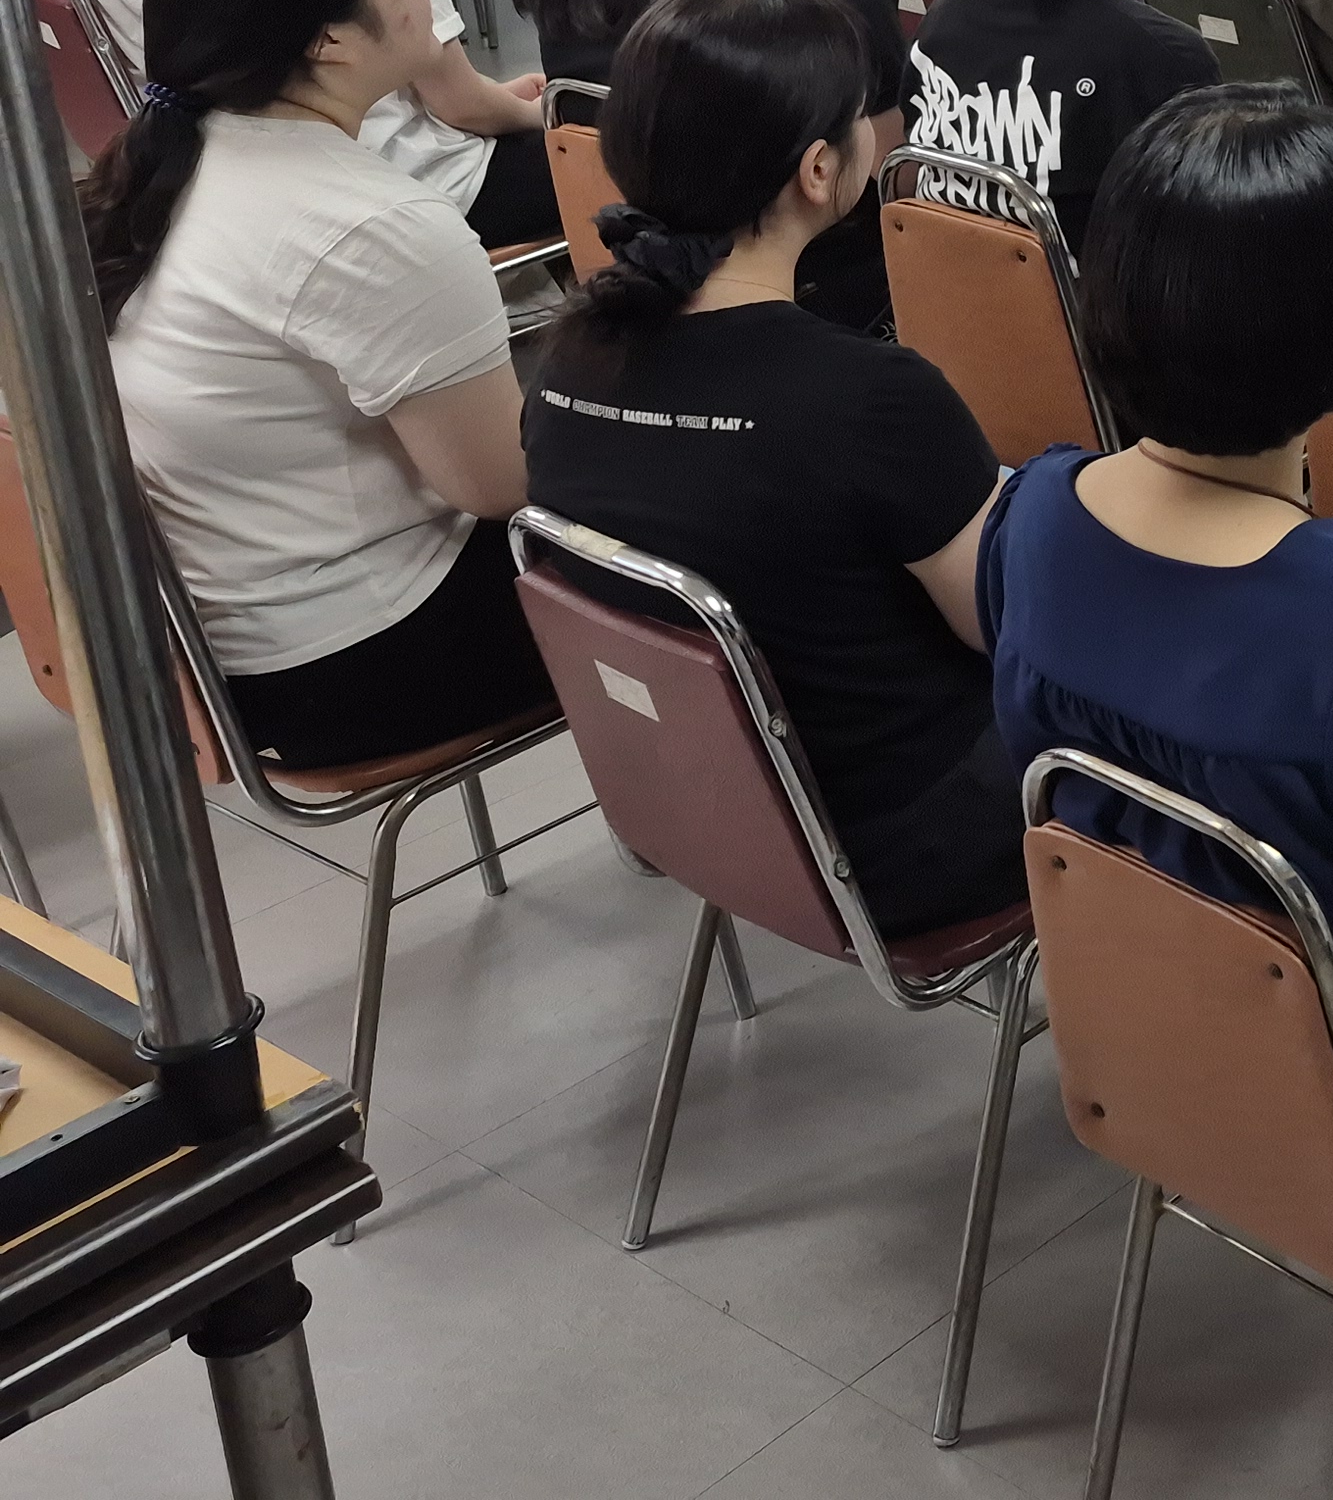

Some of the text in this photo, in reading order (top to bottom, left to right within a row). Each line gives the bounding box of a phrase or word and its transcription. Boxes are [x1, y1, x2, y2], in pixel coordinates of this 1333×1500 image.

[573, 399, 620, 420] CHAMPION
[623, 409, 673, 426] BASEBALL
[676, 415, 708, 429] TEAM
[711, 417, 742, 430] PLAY
